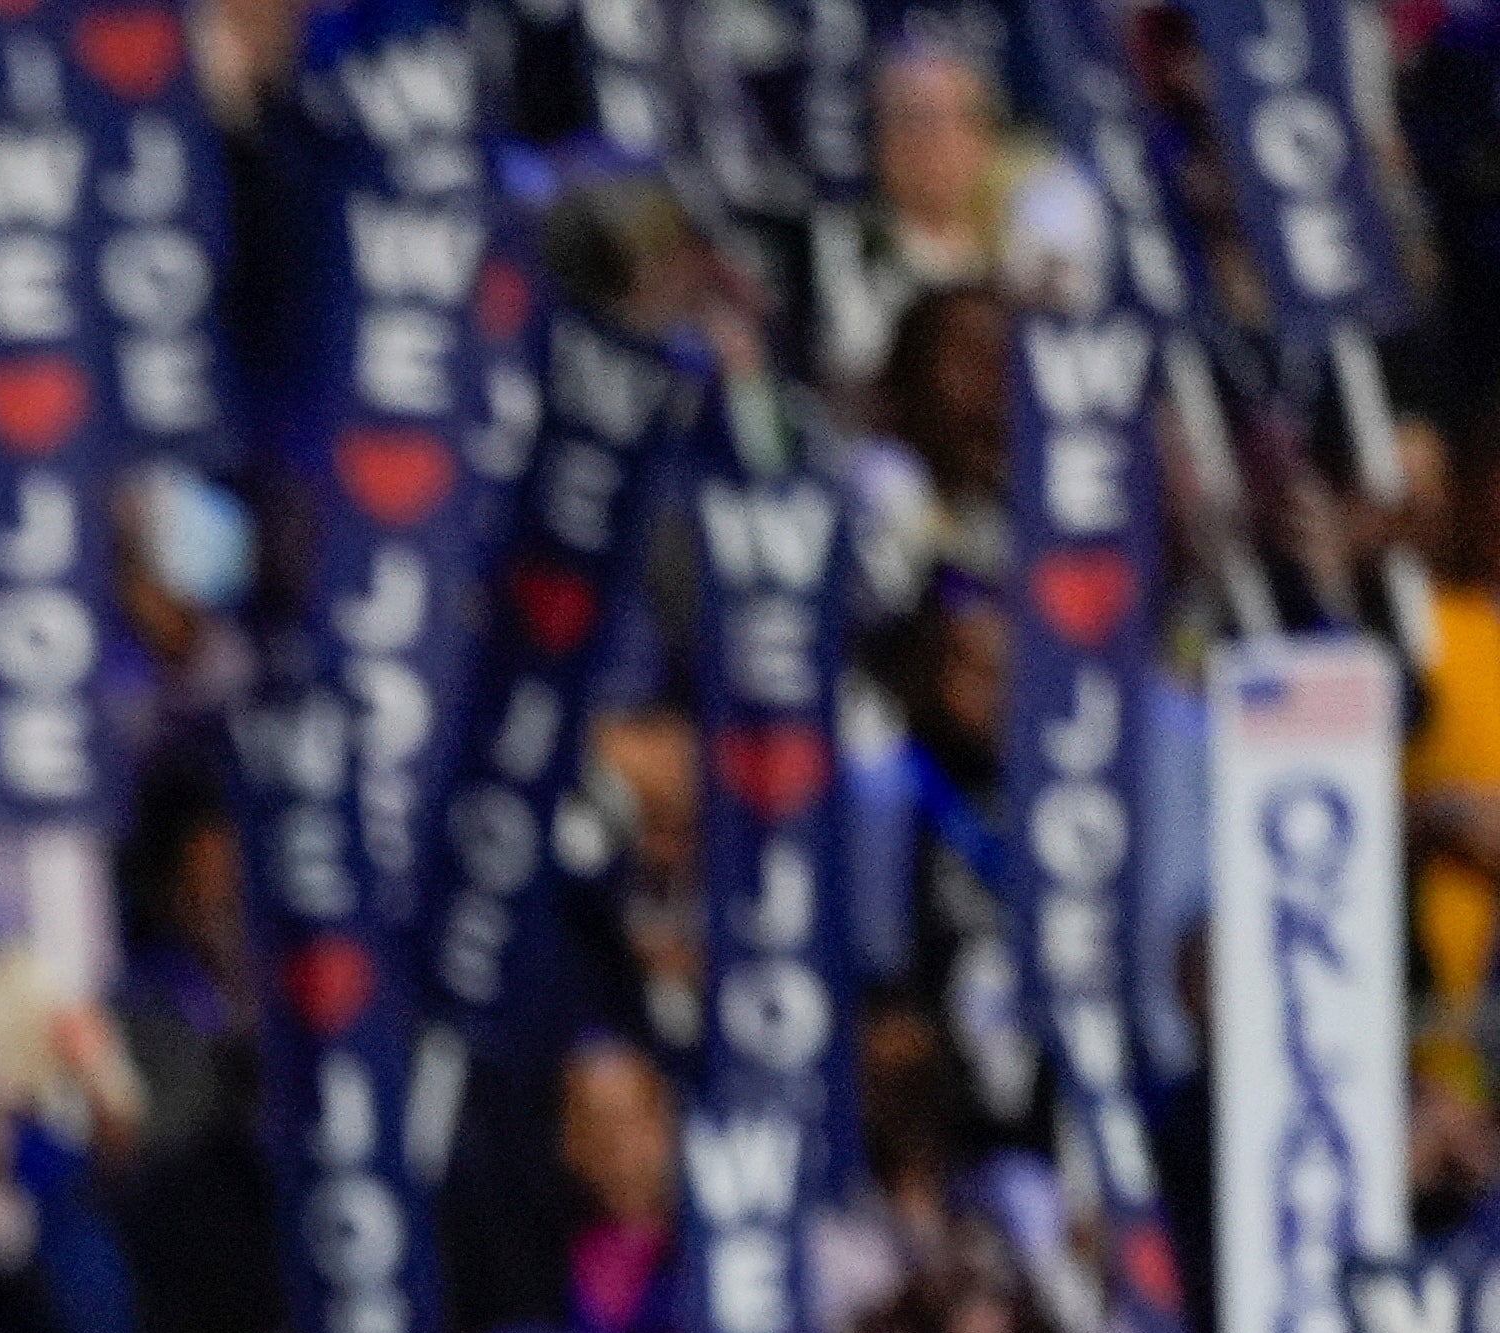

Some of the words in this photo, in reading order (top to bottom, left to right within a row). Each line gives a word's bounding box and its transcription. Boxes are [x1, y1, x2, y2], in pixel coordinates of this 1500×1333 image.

[1245, 5, 1360, 297] JOE
[100, 118, 212, 430] JOE
[330, 205, 478, 412] WE
[1025, 318, 1152, 535] WE
[700, 480, 835, 702] WE
[1030, 670, 1128, 987] JOE
[715, 840, 835, 1080] JO
